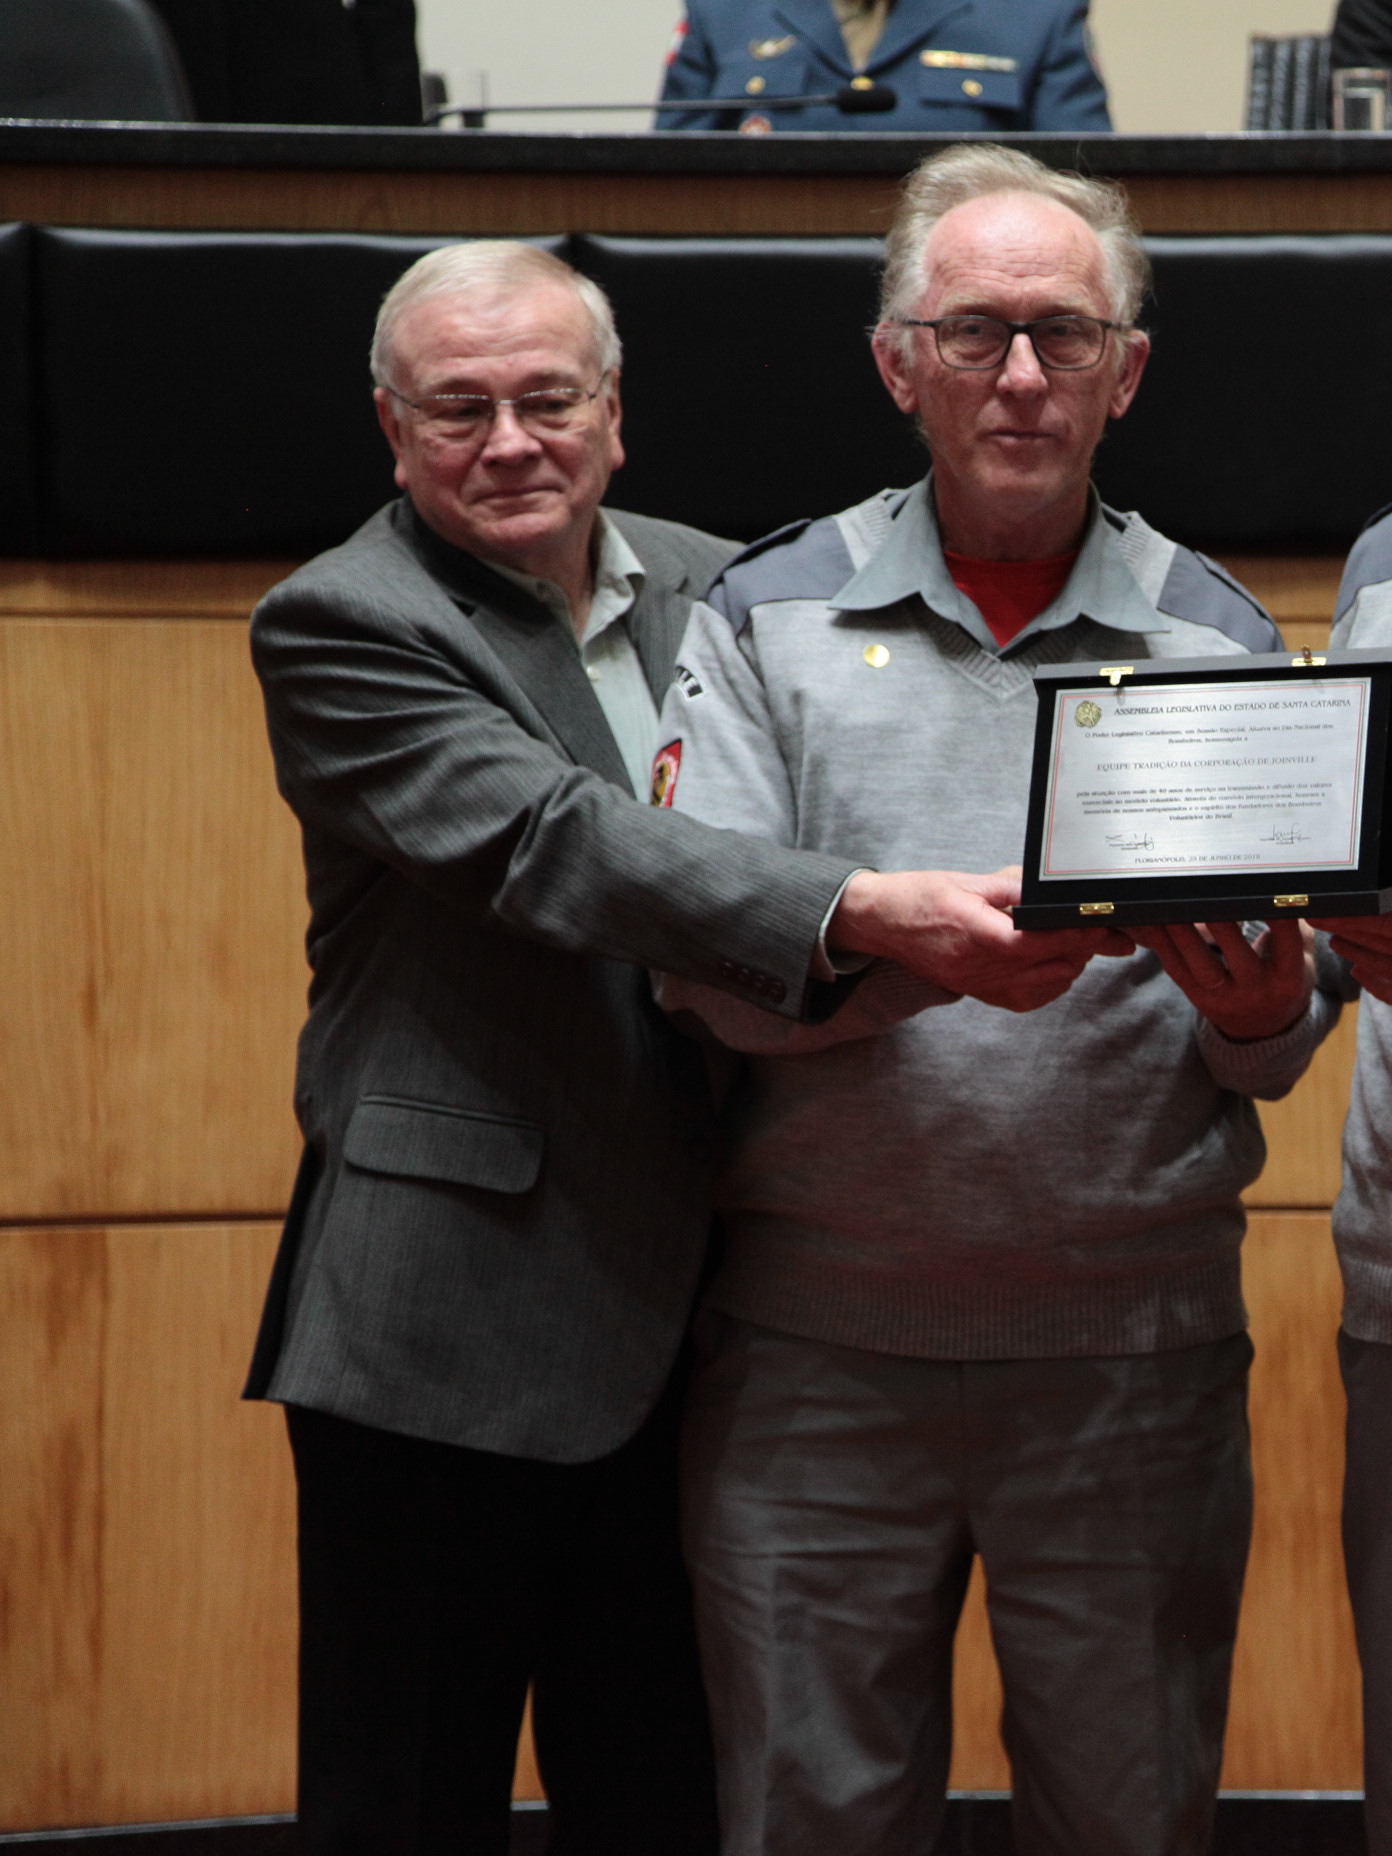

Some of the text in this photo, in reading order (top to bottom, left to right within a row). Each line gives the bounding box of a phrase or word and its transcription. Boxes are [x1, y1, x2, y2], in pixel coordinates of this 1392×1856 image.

[1114, 706, 1164, 715] ASSEMBLEIA
[1166, 704, 1217, 713] LEGISLATIVA
[1234, 702, 1266, 710] ESTADO
[1282, 700, 1308, 708] SANTA
[1310, 699, 1351, 707] CATARINA
[1097, 762, 1130, 771] EQUIPE
[1133, 760, 1178, 770] TRADIÇÃO
[1194, 757, 1255, 767] CORPORAÇÃO
[1272, 755, 1316, 764] JOINVILLE
